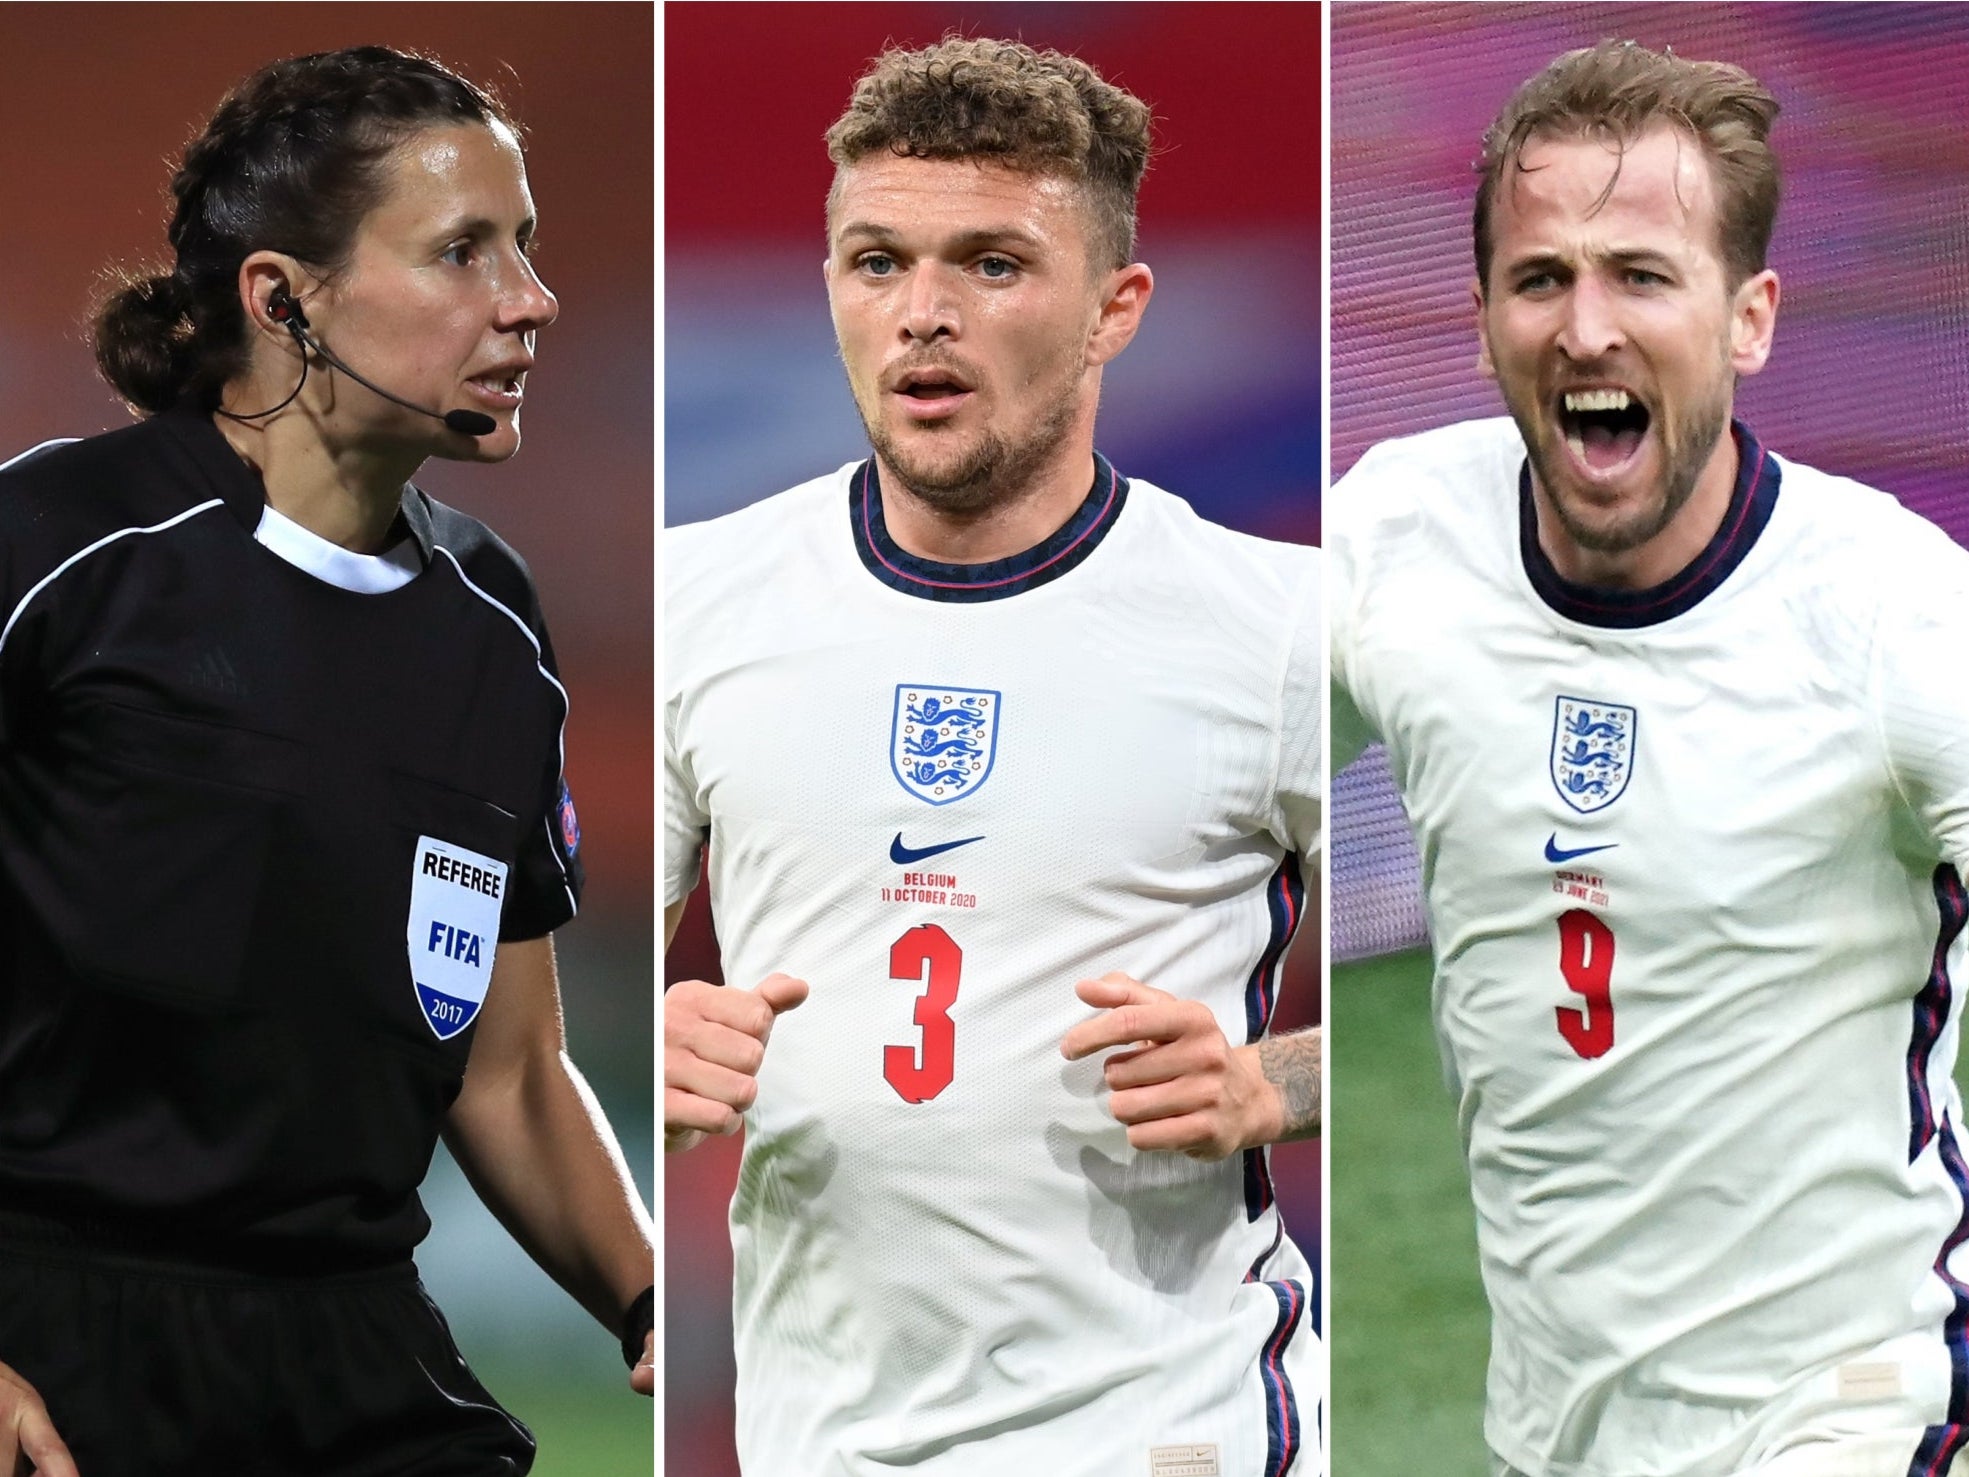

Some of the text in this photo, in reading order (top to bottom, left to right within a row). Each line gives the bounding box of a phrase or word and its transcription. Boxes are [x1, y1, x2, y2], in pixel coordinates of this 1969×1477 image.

[422, 851, 501, 899] REFEREE
[881, 887, 977, 908] 11 OCTOBER 2020
[903, 872, 956, 889] BELGIUM
[428, 920, 480, 968] FIFA
[1555, 907, 1615, 1060] 9
[431, 998, 463, 1025] 2017
[883, 923, 963, 1104] 3
